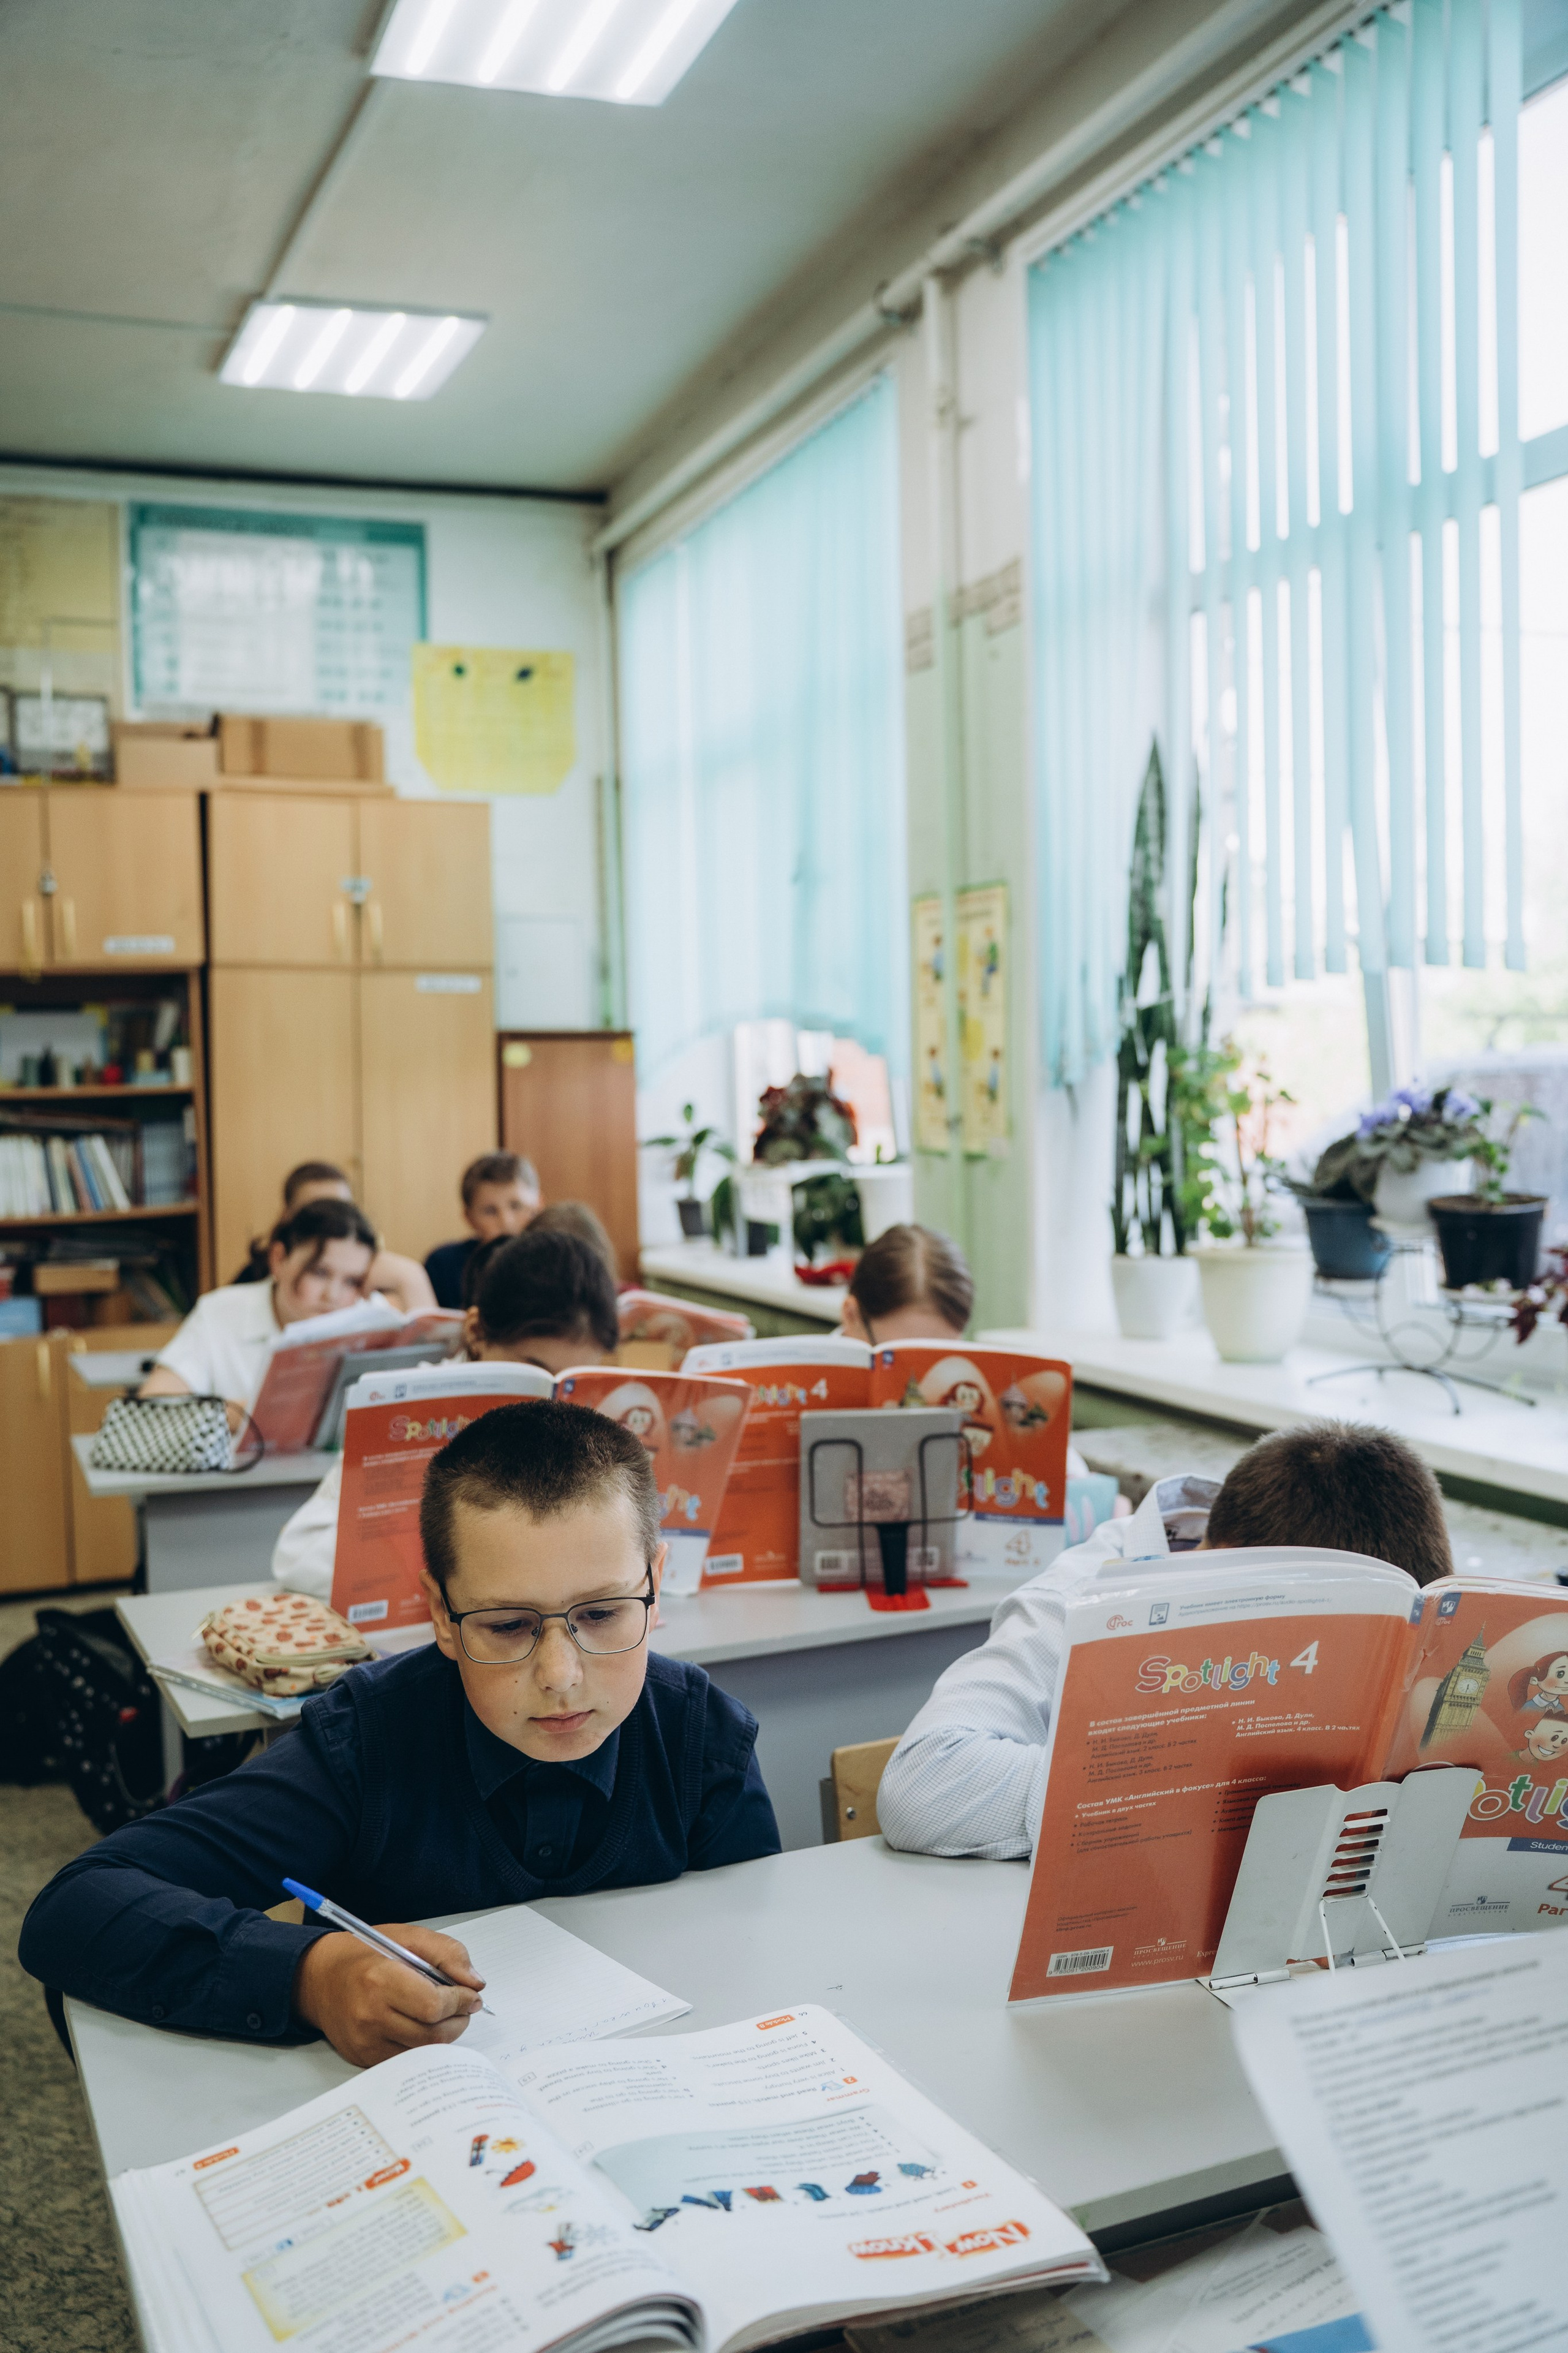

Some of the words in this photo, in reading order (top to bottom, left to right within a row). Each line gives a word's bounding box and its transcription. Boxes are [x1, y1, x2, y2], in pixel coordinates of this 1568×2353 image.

[810, 1377, 828, 1400] 4
[389, 1414, 470, 1441] Spotlig
[1135, 1652, 1280, 1693] Spotlight
[1289, 1640, 1319, 1674] 4
[1097, 1717, 1122, 1726] состав
[1124, 1708, 1178, 1723] завершённой
[1180, 1701, 1229, 1715] предметной
[1231, 1699, 1254, 1707] линии
[1088, 1727, 1115, 1735] входят
[1117, 1720, 1164, 1731] следующие
[1166, 1713, 1207, 1725] учебники:
[1235, 1728, 1275, 1737] Английский
[1076, 1801, 1103, 1810] Состав
[1105, 1796, 1122, 1804] УМК
[1124, 1788, 1174, 1802] «Английский
[1182, 1783, 1213, 1793] фокусе»
[1082, 1809, 1110, 1818] Учебник
[1530, 1841, 1568, 1851] Studen
[1449, 1905, 1509, 1913] ПРОСВЕЩЕНИЕ
[1537, 1903, 1568, 1916] Par
[1134, 1943, 1186, 1955] ПРОСВЕЩЕНИЕ
[1131, 1955, 1183, 1966] www.prosv.ru
[766, 2016, 791, 2026] Module
[786, 2033, 798, 2042] Jeff
[755, 2039, 777, 2050] going
[787, 2042, 809, 2052] Fiona
[756, 2050, 779, 2061] going
[799, 2051, 817, 2060] Mike
[790, 2064, 812, 2074] wants
[827, 2088, 870, 2102] Grammar
[956, 2222, 1024, 2254] Now
[851, 2235, 925, 2255] know
